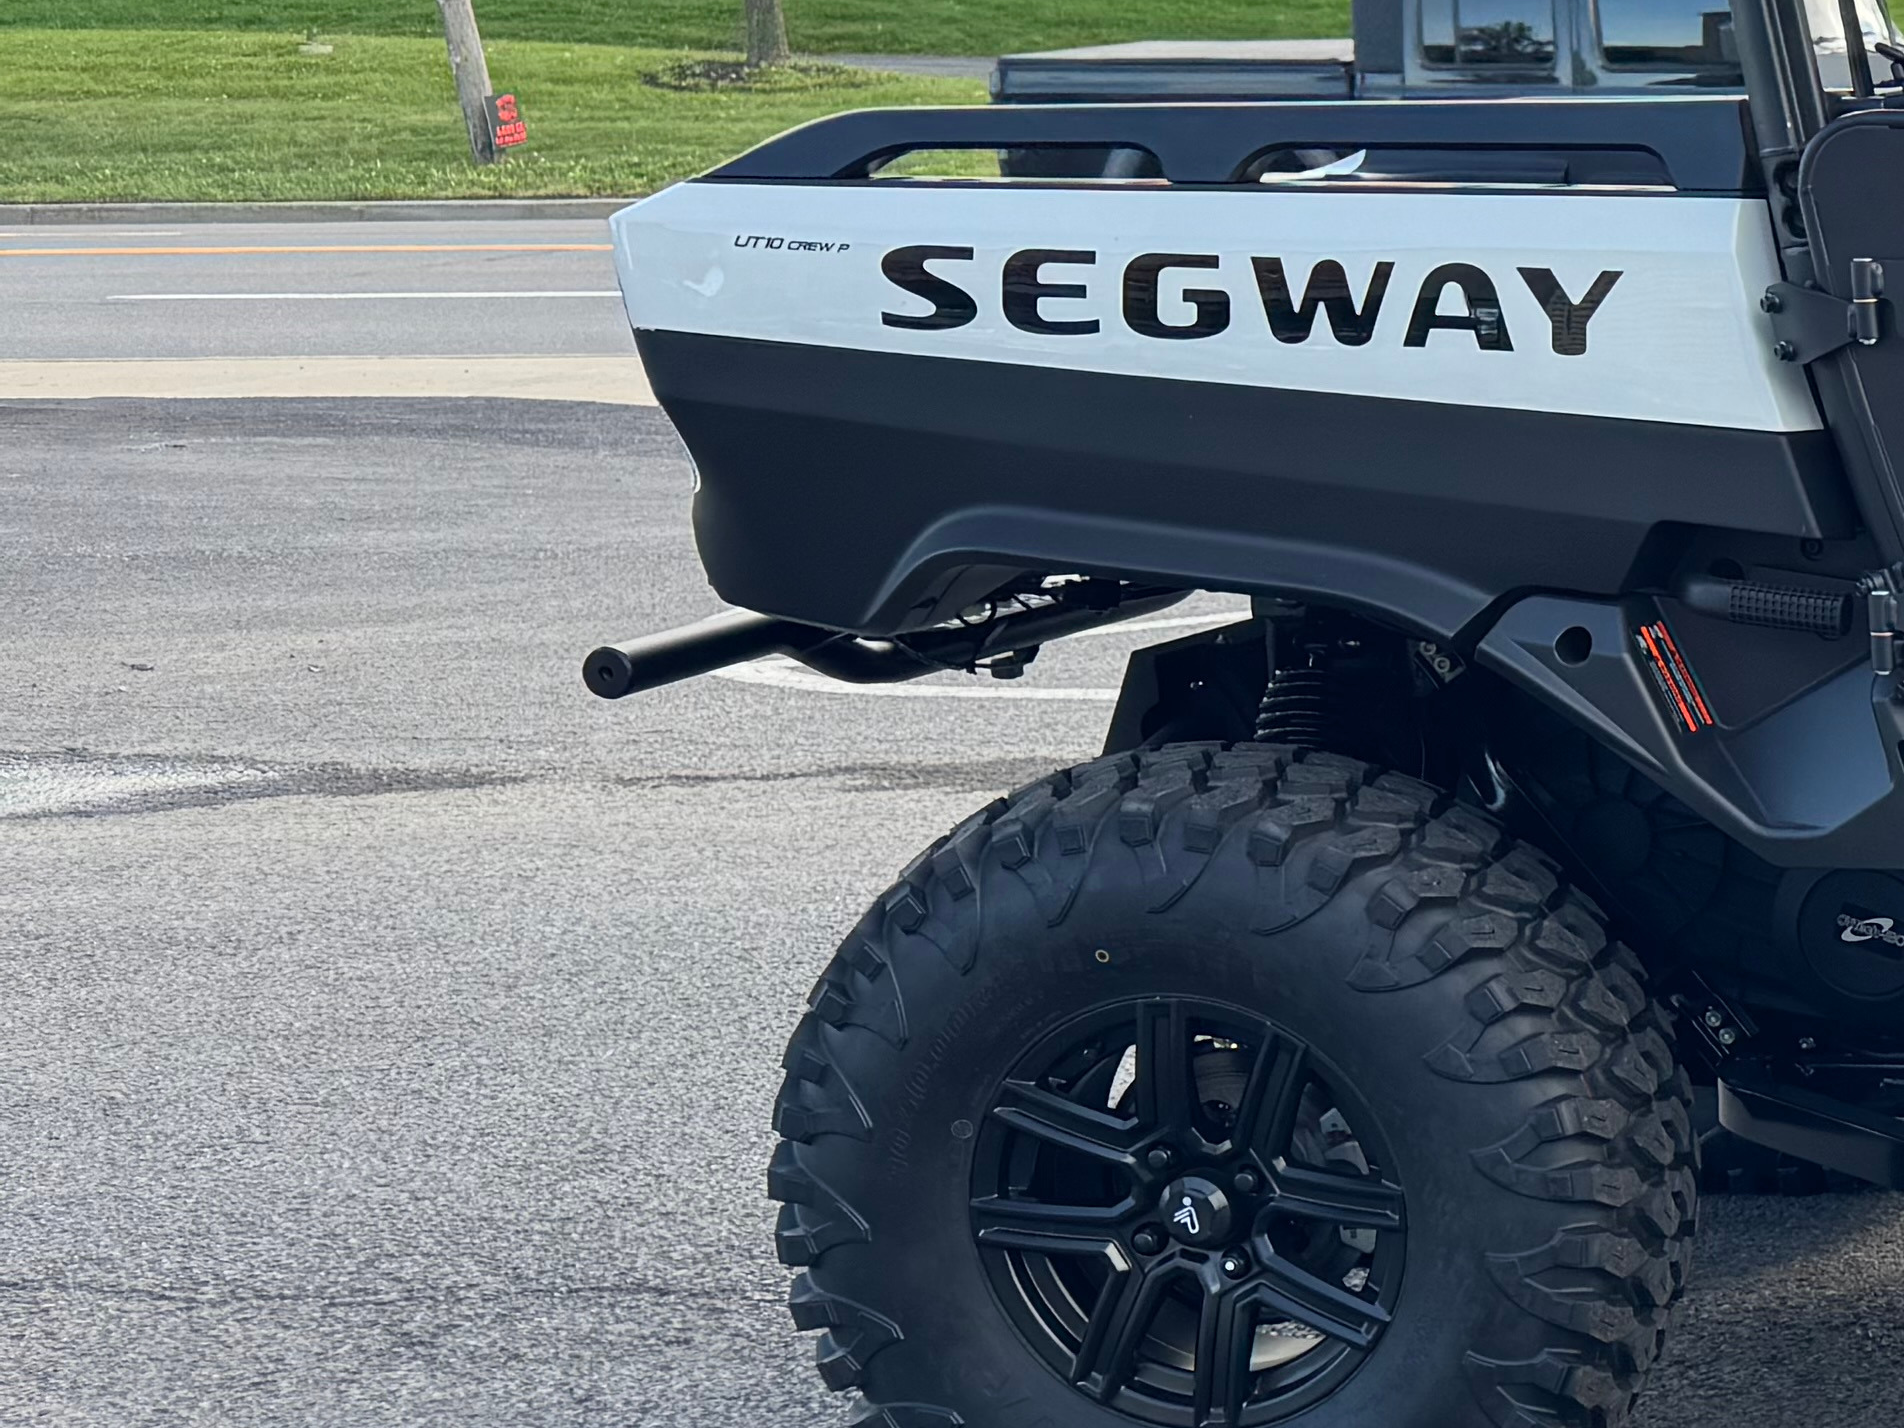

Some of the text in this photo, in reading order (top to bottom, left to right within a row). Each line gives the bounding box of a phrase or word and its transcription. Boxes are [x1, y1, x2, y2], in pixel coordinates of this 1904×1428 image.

[734, 235, 851, 253] UT10 CREW P
[881, 245, 1624, 356] SEGWAY
